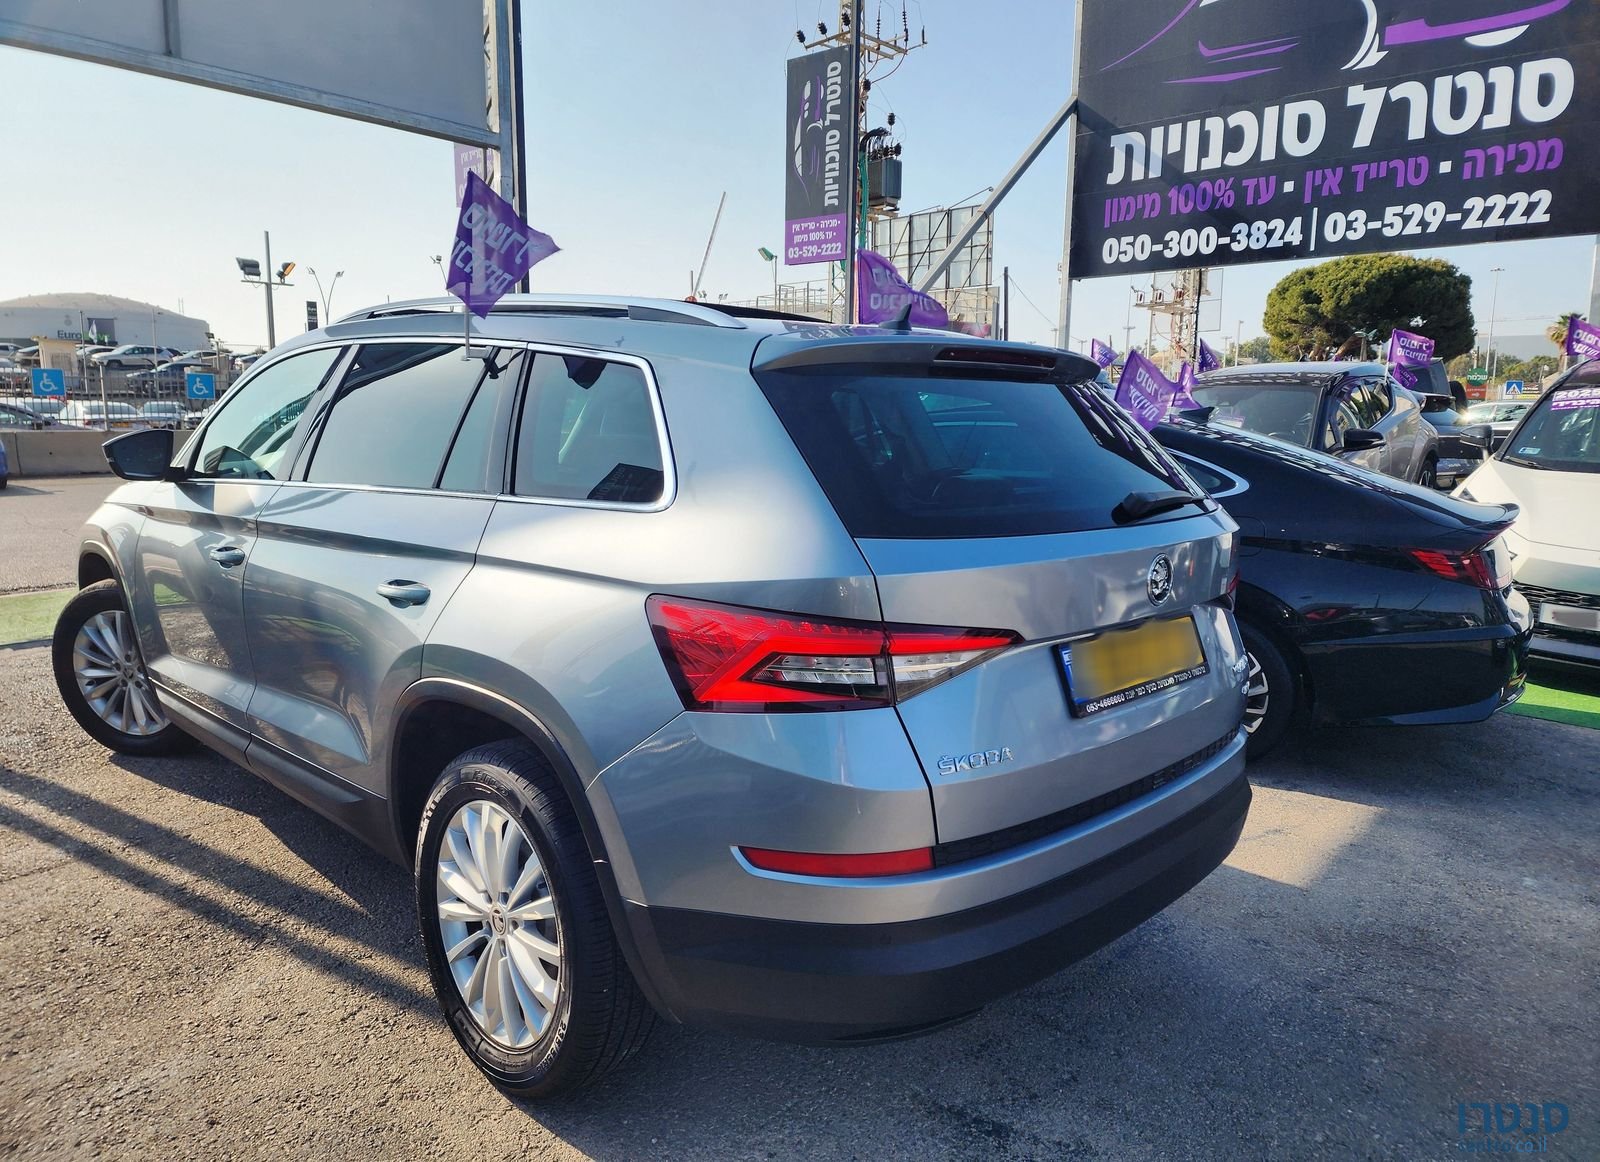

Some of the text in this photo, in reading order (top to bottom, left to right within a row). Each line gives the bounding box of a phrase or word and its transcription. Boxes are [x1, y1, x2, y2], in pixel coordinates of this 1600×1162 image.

[823, 61, 842, 207] סנטרל סוכנויות
[1106, 57, 1575, 185] סנטרל סוכנויות
[1104, 137, 1565, 228] מכירה טרייד אין עד 100% מימון
[809, 231, 825, 241] 100%
[820, 219, 838, 229] מכירה
[825, 231, 833, 239] עד
[1102, 189, 1553, 265] 050-300-3824 03-529-2222
[788, 242, 842, 258] 03-529-2222
[938, 746, 1014, 776] ŠKODA
